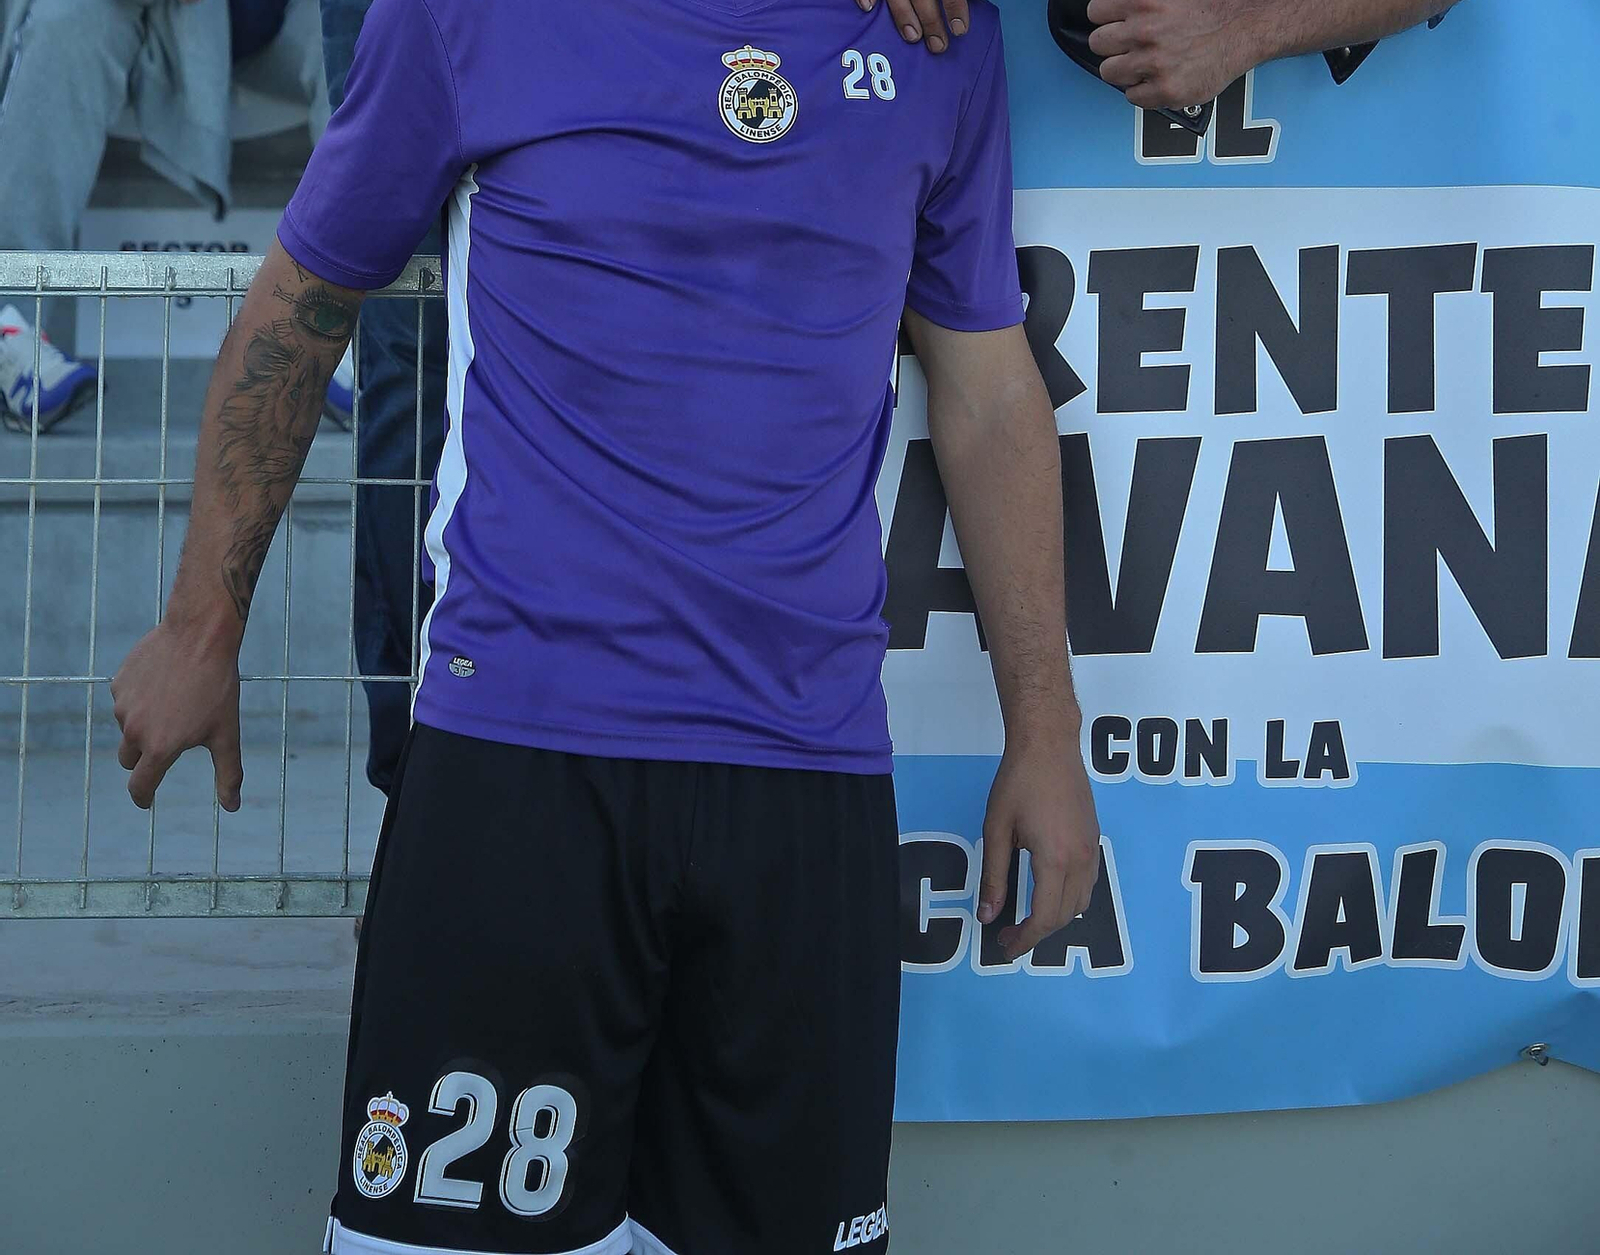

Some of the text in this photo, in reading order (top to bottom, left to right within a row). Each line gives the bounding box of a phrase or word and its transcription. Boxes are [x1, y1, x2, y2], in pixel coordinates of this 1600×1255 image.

[724, 84, 737, 111] REAL
[842, 49, 897, 101] 28
[739, 123, 784, 138] LINENSE
[890, 243, 1595, 414] RENTE
[1091, 714, 1351, 781] CON LA
[1191, 847, 1600, 979] BALO
[413, 1071, 577, 1217] 28
[359, 1175, 389, 1195] LINENSE
